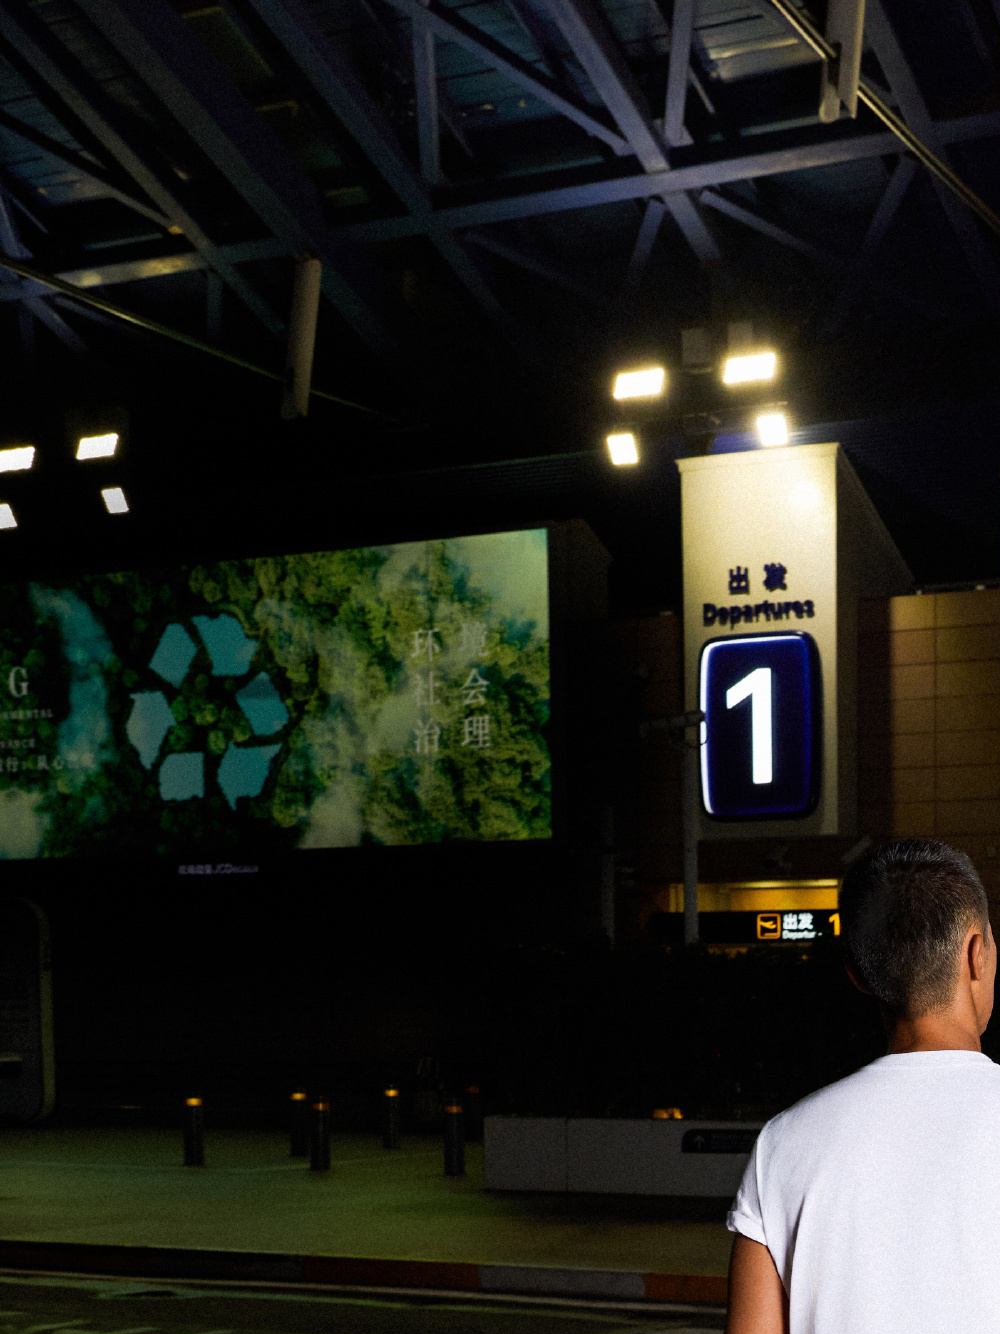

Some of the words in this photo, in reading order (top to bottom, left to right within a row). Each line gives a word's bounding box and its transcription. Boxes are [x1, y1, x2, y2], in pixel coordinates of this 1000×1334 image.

[729, 562, 787, 595] 出发
[702, 600, 815, 630] Departures
[726, 667, 773, 785] 1
[783, 912, 813, 929] 出发
